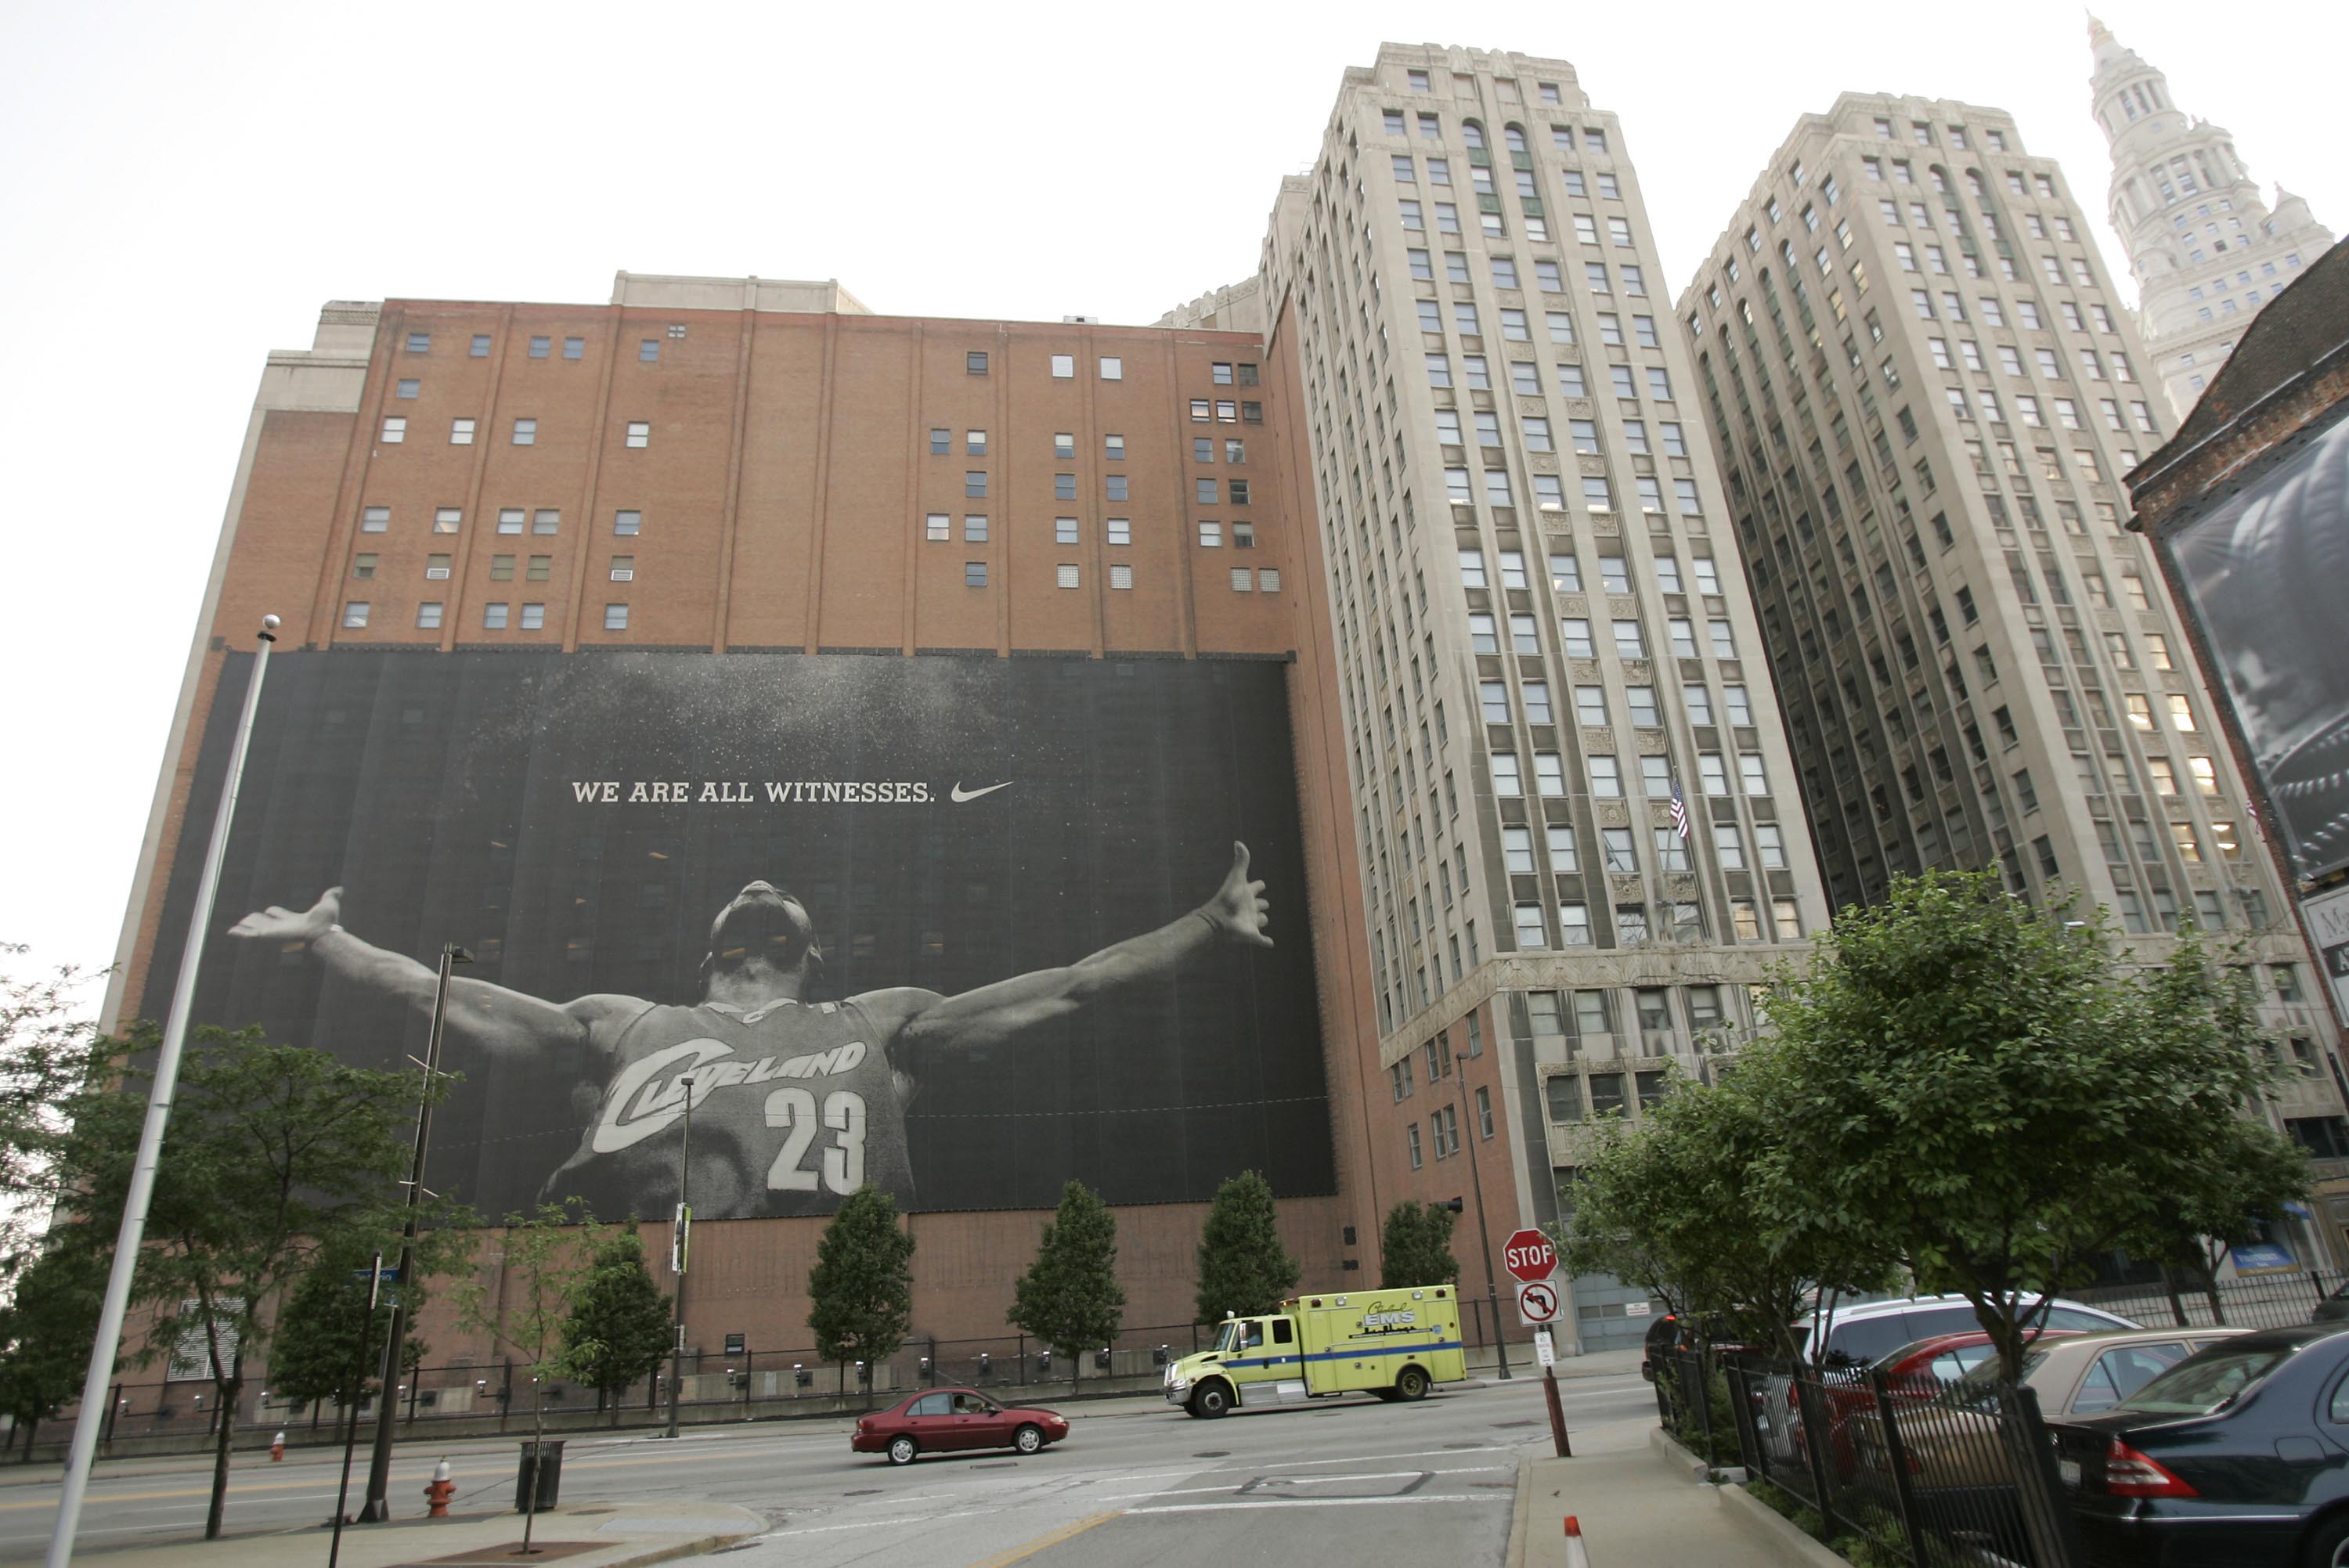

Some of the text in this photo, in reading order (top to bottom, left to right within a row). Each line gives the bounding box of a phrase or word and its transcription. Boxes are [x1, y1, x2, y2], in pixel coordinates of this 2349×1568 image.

[572, 782, 936, 802] WE ARE ALL WITNESSES.
[765, 1088, 867, 1196] 23
[1507, 1244, 1553, 1269] STOP
[1364, 1311, 1415, 1326] EMS
